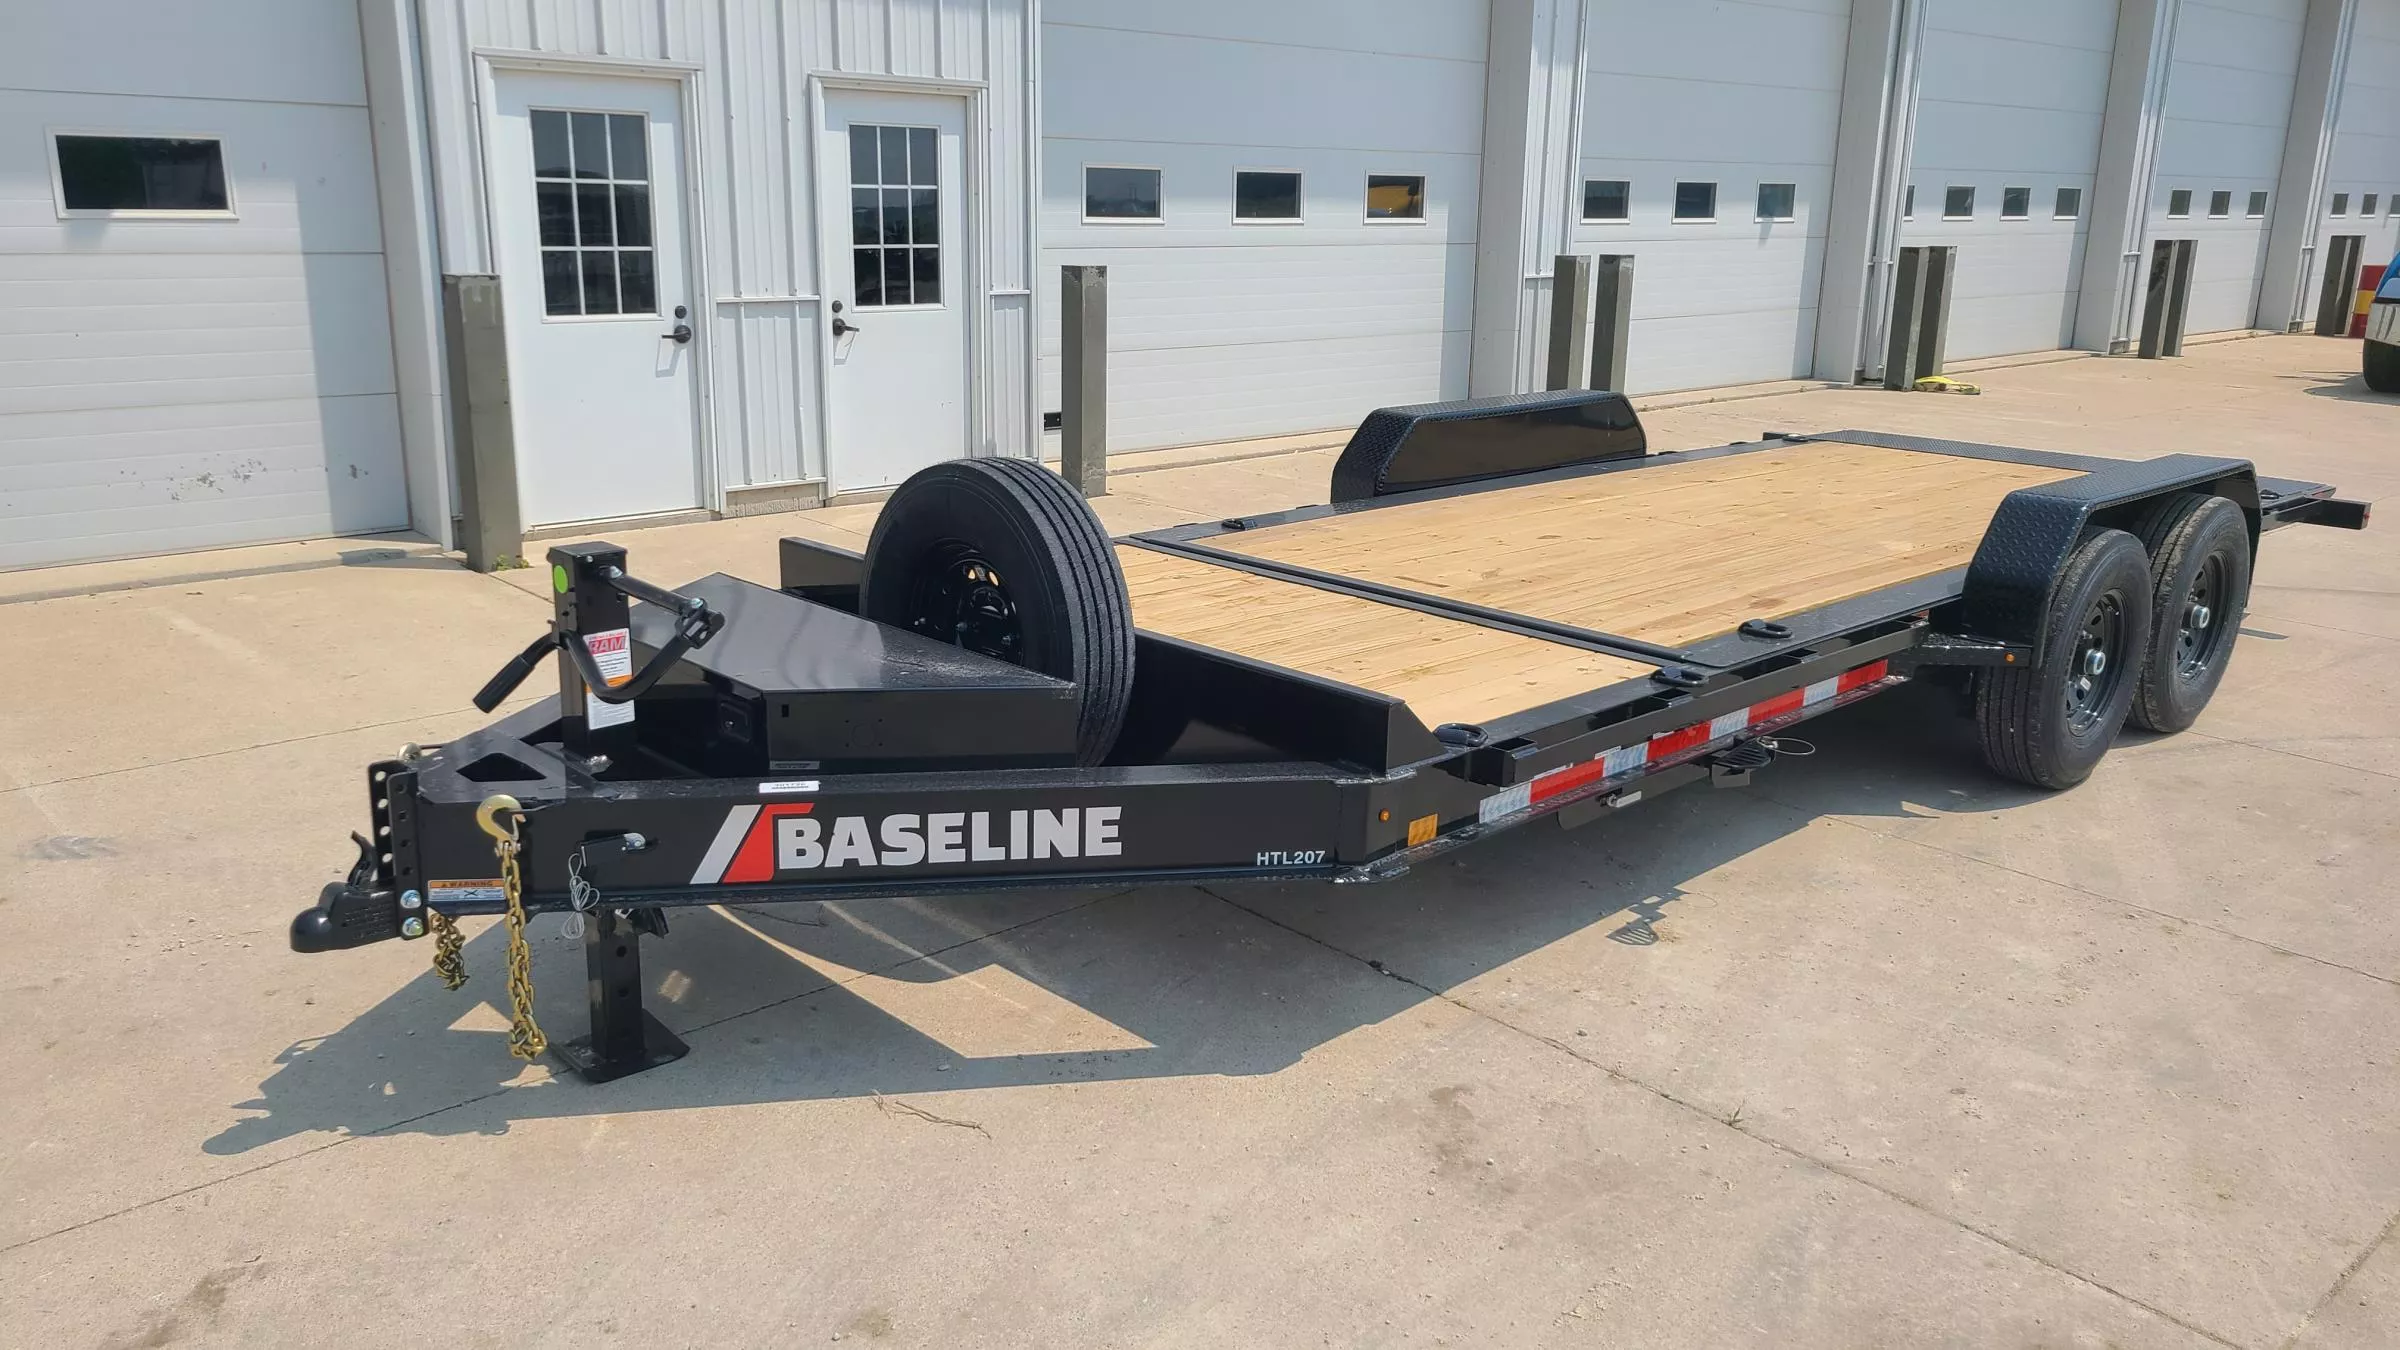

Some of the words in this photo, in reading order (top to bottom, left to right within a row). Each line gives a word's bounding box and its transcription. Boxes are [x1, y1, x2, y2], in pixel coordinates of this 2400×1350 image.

[589, 636, 626, 655] RAM
[777, 806, 1122, 870] BASELINE
[1256, 850, 1326, 866] HTL207
[449, 880, 494, 888] WARNING
